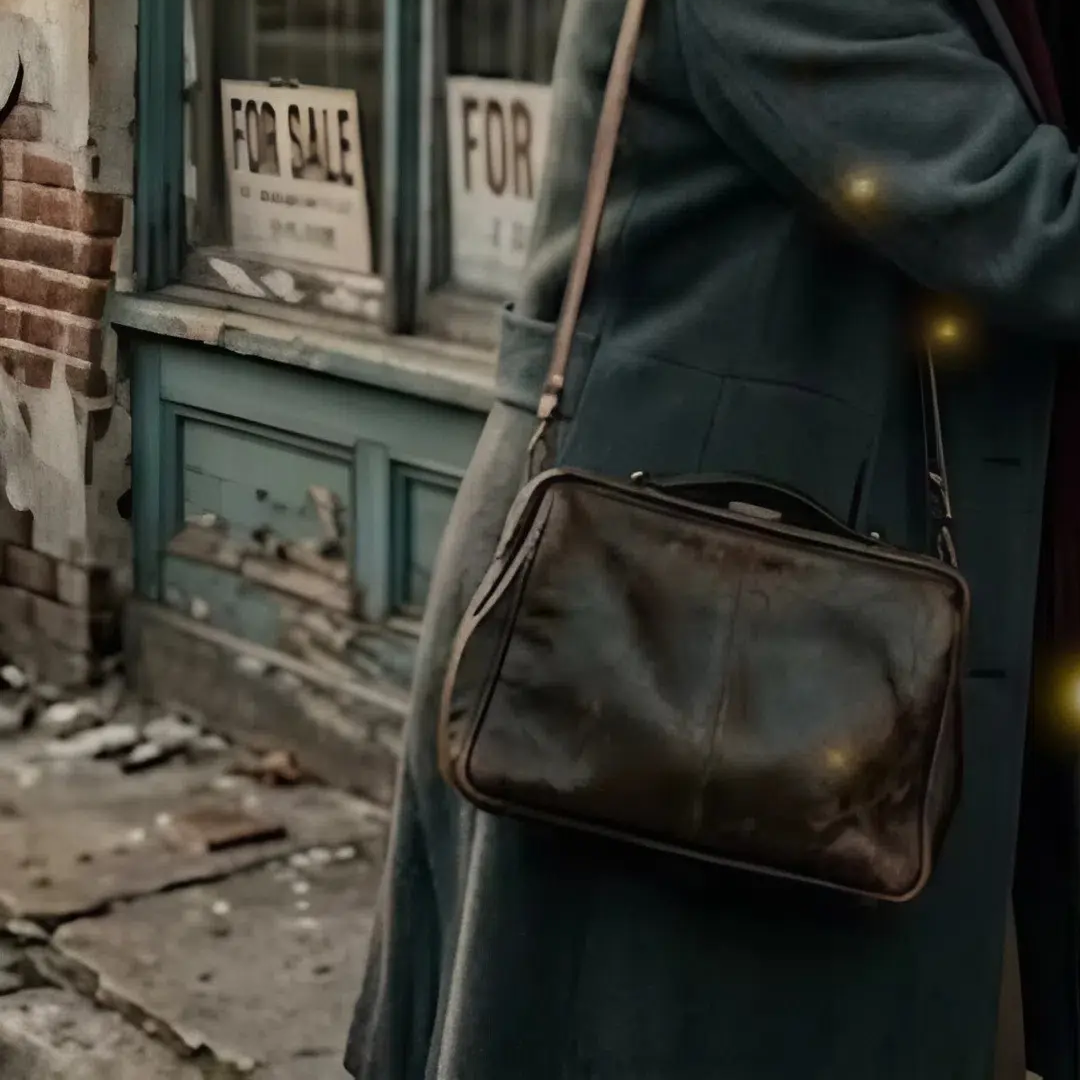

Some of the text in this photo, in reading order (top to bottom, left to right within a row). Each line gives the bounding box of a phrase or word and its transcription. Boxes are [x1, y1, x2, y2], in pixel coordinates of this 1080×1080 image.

[231, 98, 354, 187] FOR SALE
[462, 95, 534, 201] FOR
